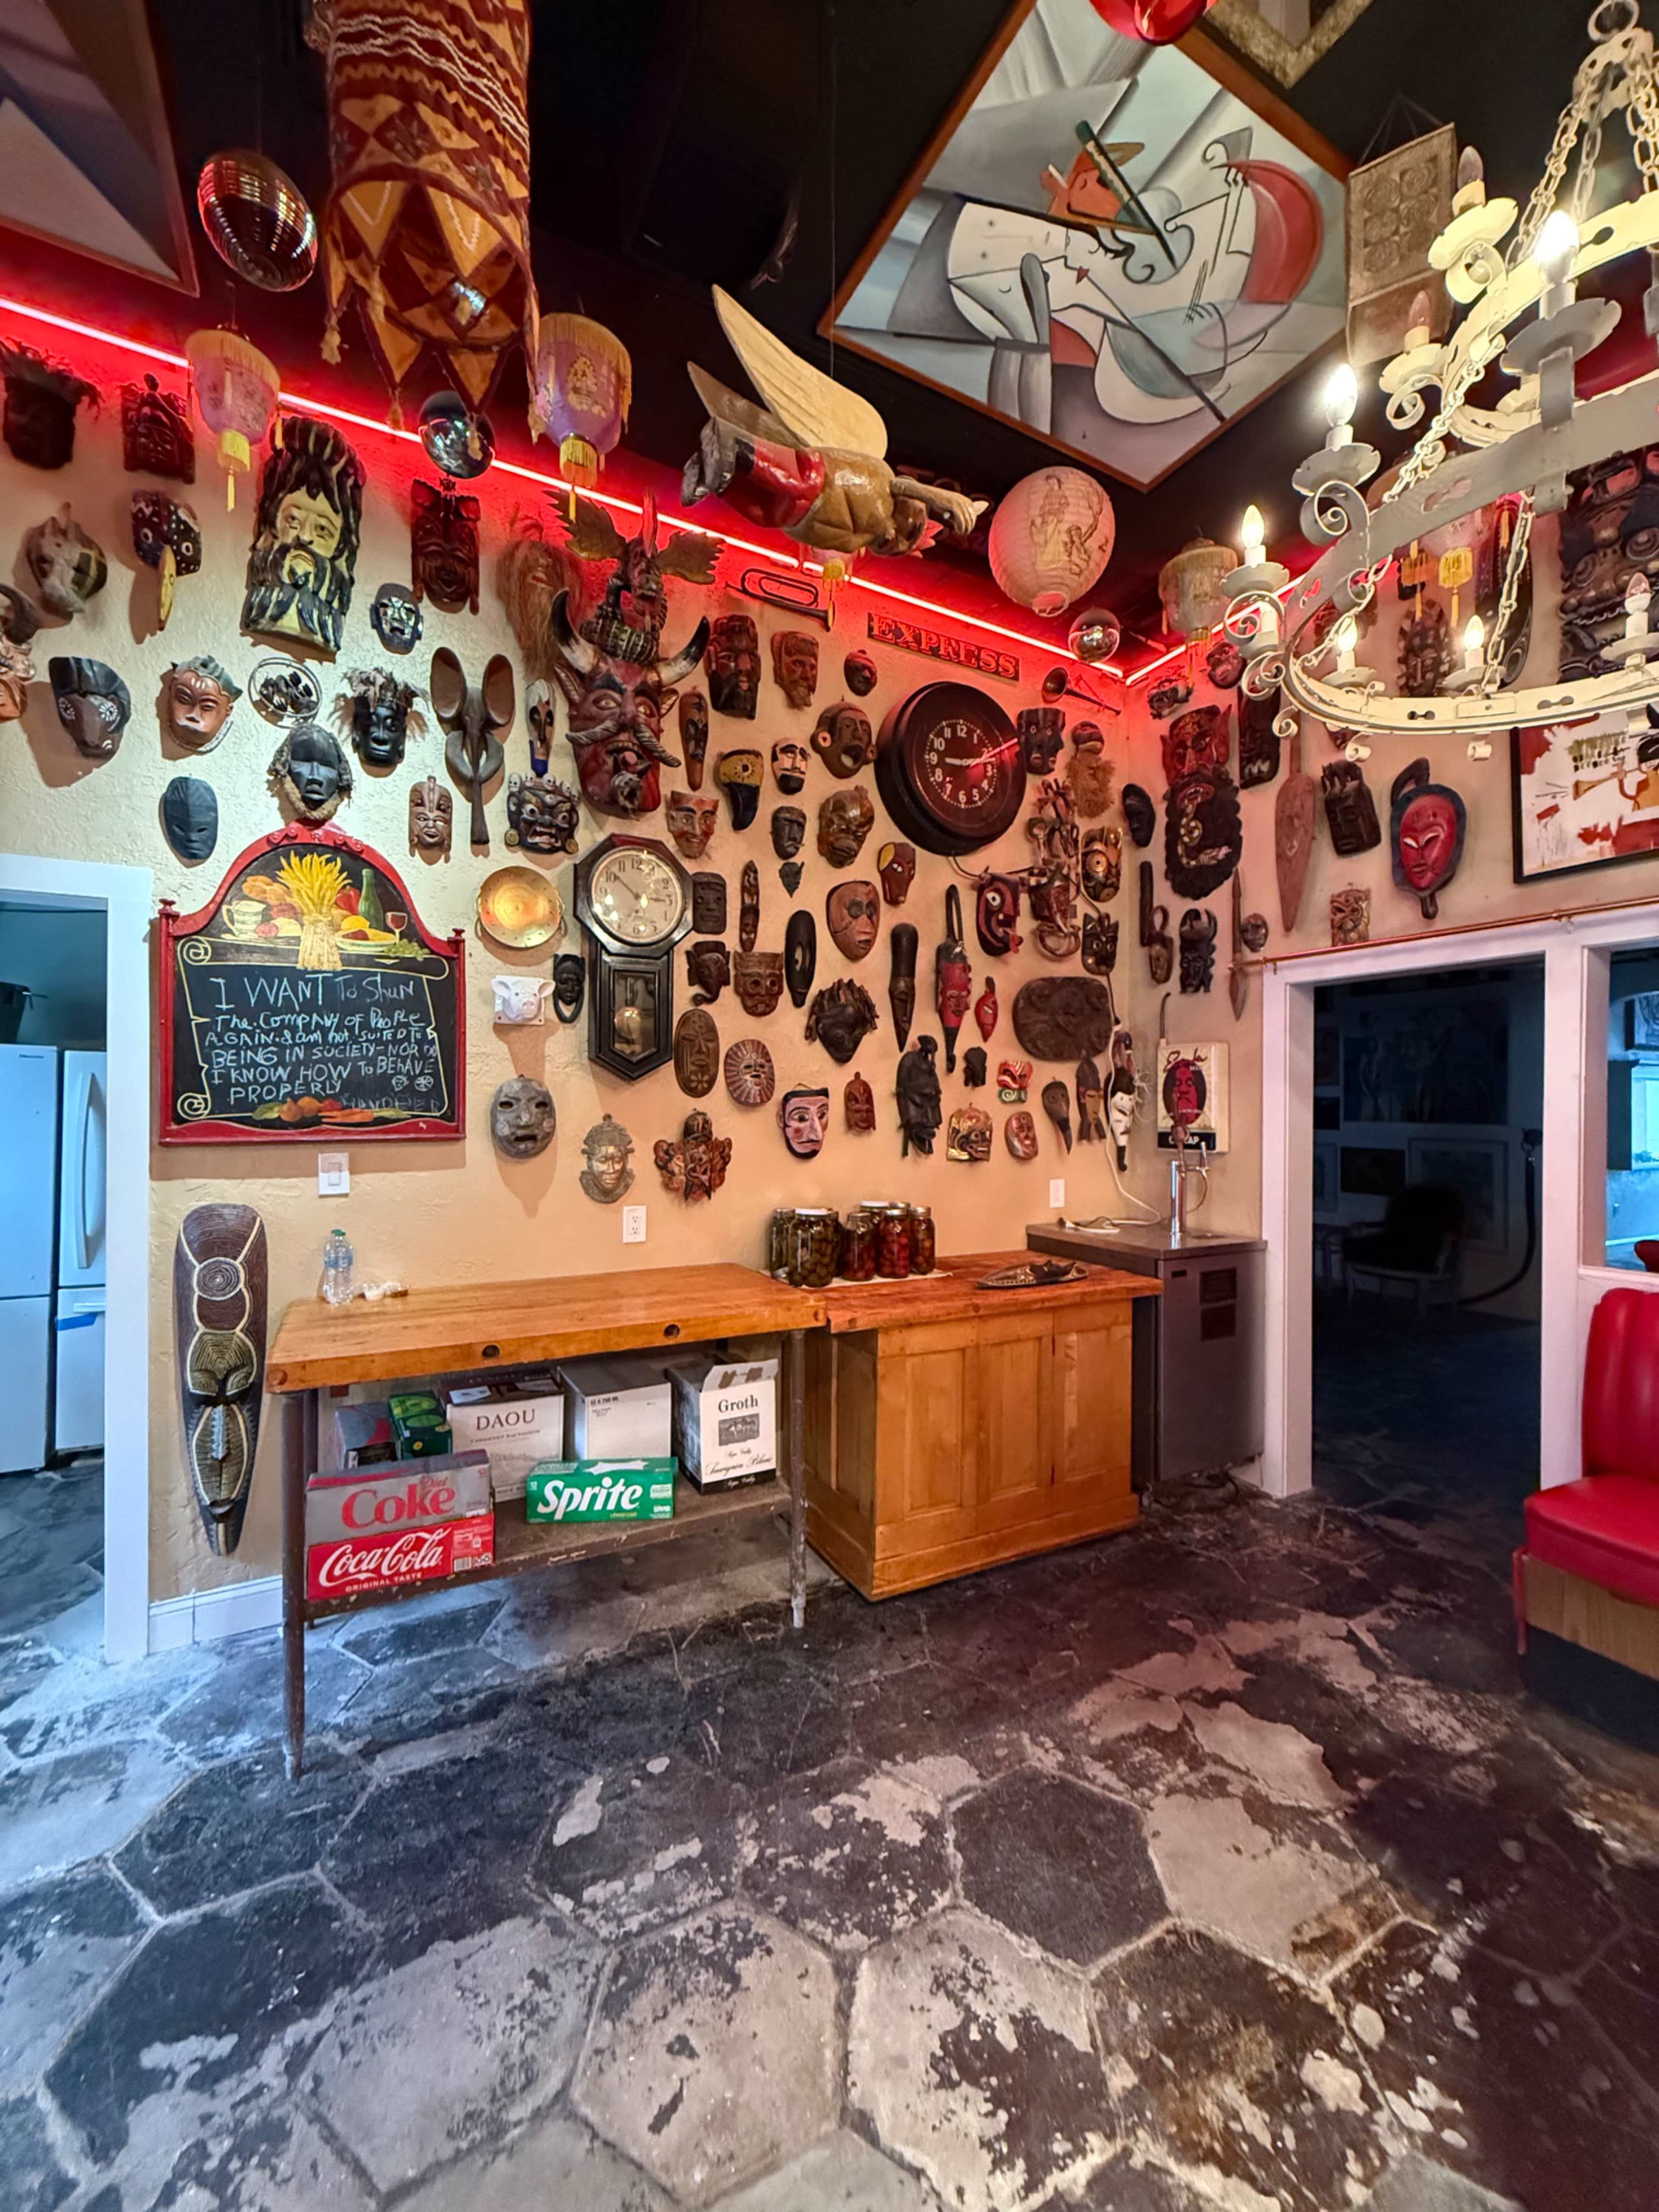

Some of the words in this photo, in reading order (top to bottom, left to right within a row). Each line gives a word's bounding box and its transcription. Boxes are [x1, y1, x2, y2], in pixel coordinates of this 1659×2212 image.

[871, 612, 1016, 678] EXPRESS
[944, 727, 951, 739] 11
[957, 725, 967, 737] 12
[973, 732, 978, 744] 1
[934, 737, 945, 751] 10
[930, 752, 938, 765] 9
[935, 767, 943, 782] 8
[986, 764, 992, 776] 3
[946, 783, 952, 795] 7
[981, 779, 988, 791] 4
[959, 790, 966, 803] 6
[972, 788, 979, 801] 5
[618, 861, 626, 872] 11
[632, 858, 642, 871] 12
[606, 871, 616, 883] 10
[662, 878, 669, 889] 2
[210, 978, 235, 1011] I
[244, 973, 333, 1011] WANT
[286, 1045, 305, 1063] IN
[388, 1042, 419, 1058] NOR
[211, 1069, 226, 1084] I
[231, 1065, 292, 1083] KNOW
[300, 1062, 352, 1083] HOW
[230, 1079, 342, 1106] PROPERLY
[718, 1394, 758, 1413] Groth
[477, 1408, 535, 1431] DAOU
[419, 1475, 448, 1491] Diet
[537, 1477, 643, 1520] Sprite
[341, 1483, 456, 1529] Coke
[319, 1528, 452, 1587] Coca-Cola
[345, 1579, 391, 1592] ORIGINAL
[394, 1572, 422, 1583] TASTE
